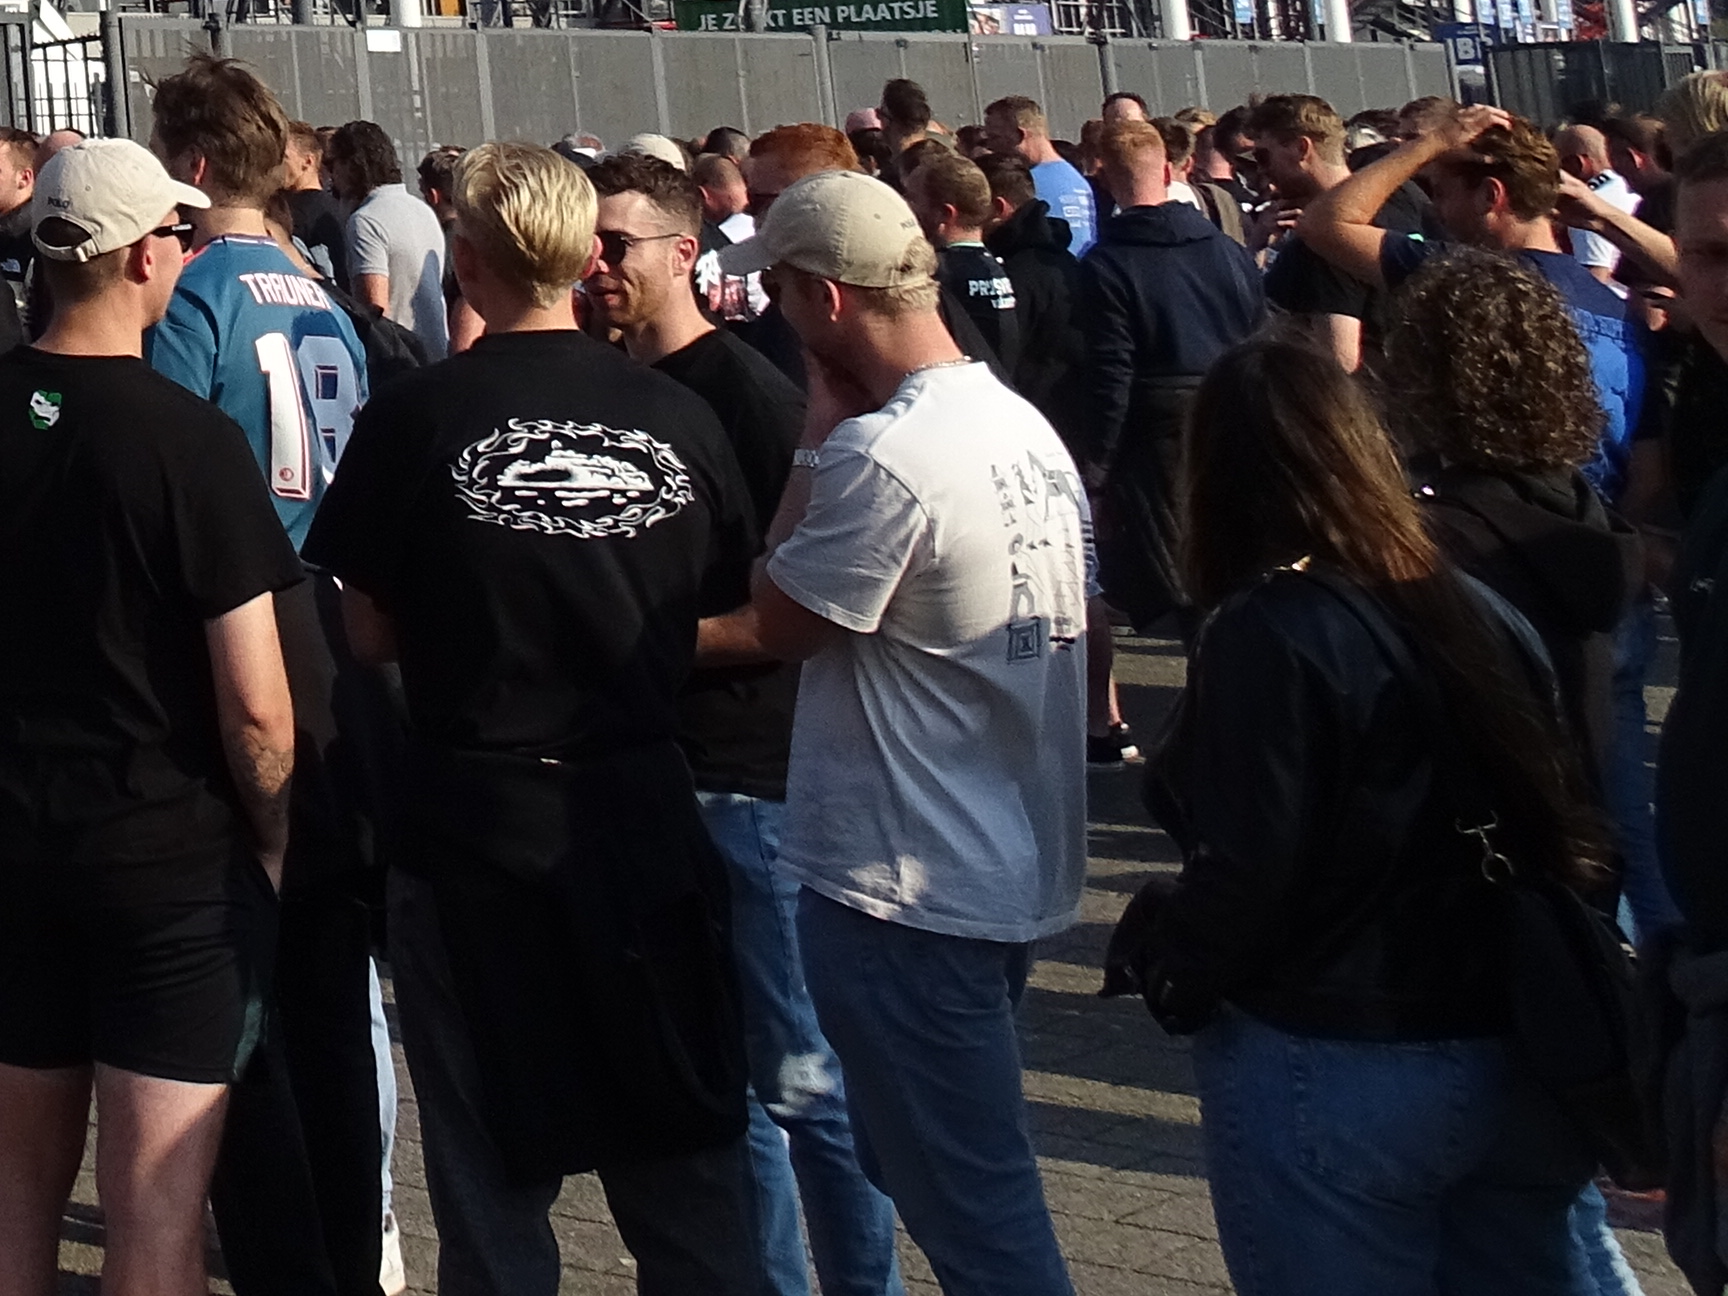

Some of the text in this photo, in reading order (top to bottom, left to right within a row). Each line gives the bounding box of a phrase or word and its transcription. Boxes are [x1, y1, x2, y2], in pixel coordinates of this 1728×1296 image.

[698, 0, 939, 31] JE ZKT EEN PLAATSJE
[239, 272, 332, 309] TRAUNER
[254, 332, 362, 501] 18
